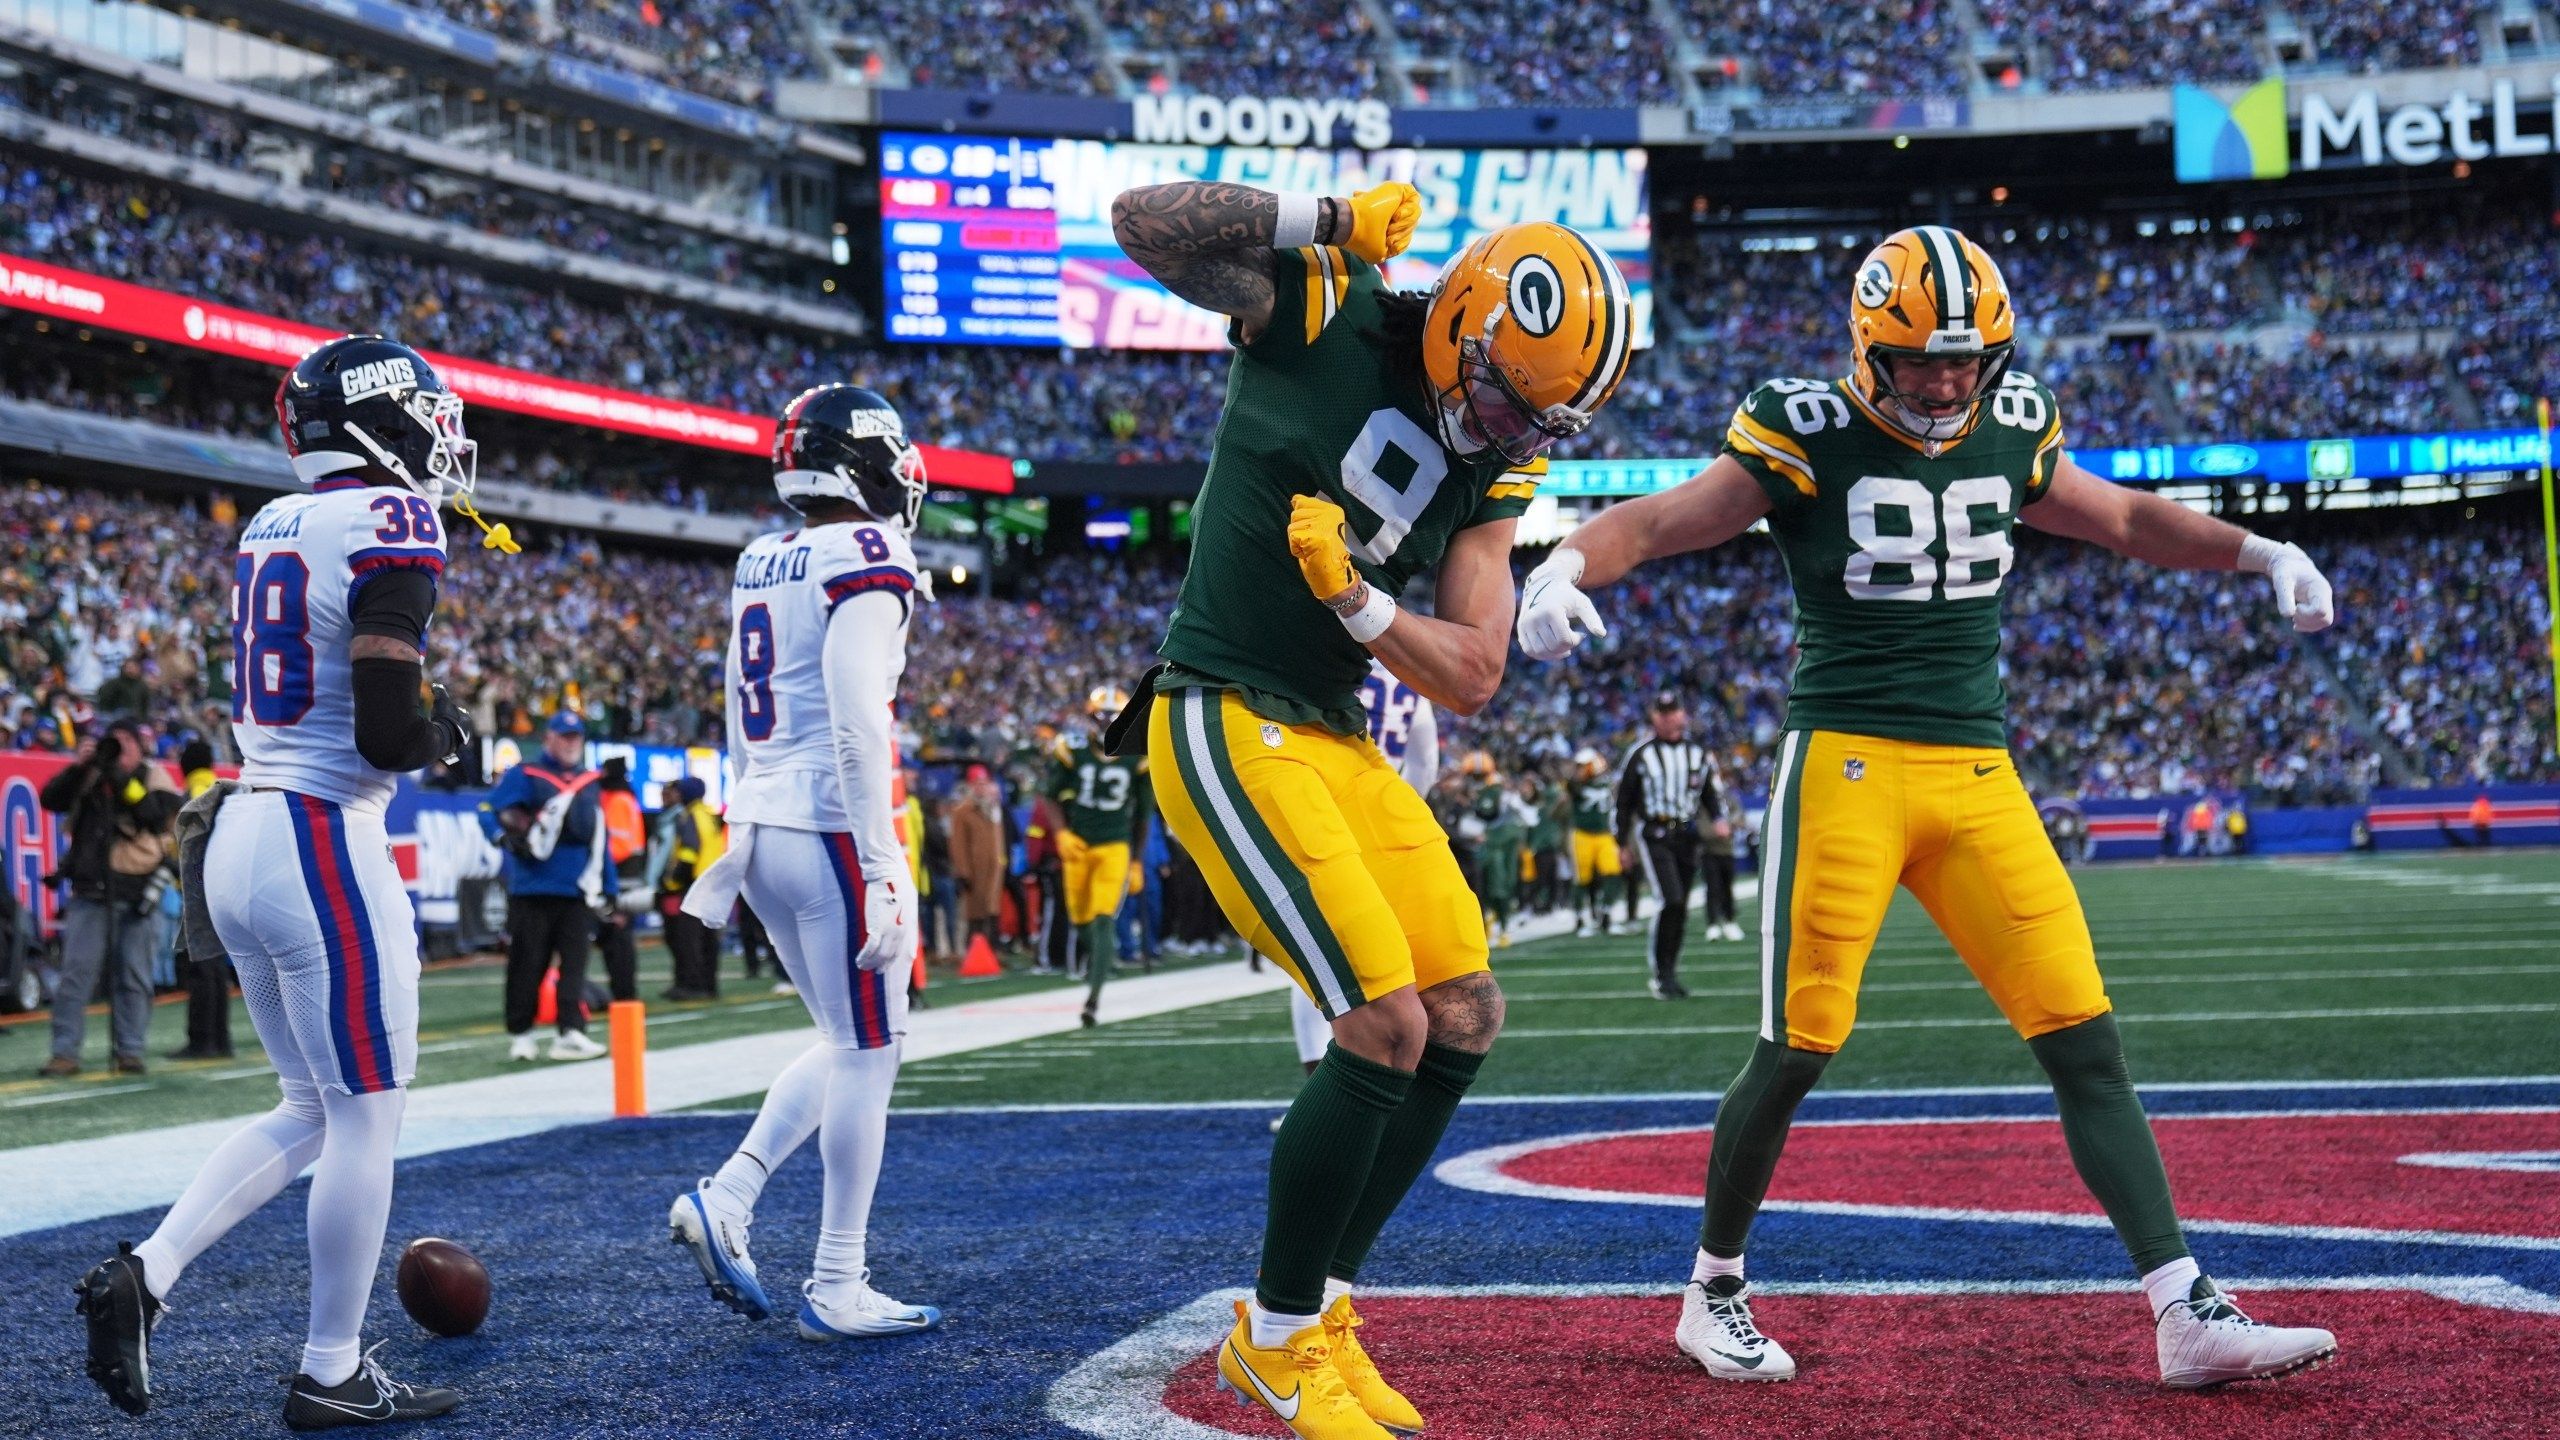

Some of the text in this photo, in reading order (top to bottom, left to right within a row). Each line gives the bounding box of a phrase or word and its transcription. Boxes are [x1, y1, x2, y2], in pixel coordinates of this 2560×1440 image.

[1132, 94, 1392, 149] MOODY'S
[1942, 334, 1971, 344] PACKERS
[340, 357, 417, 397] GIANTS
[1318, 407, 1449, 566] 9
[370, 495, 439, 544] 38
[1843, 475, 2014, 601] 86
[853, 527, 891, 564] 8
[1077, 763, 1131, 811] 13
